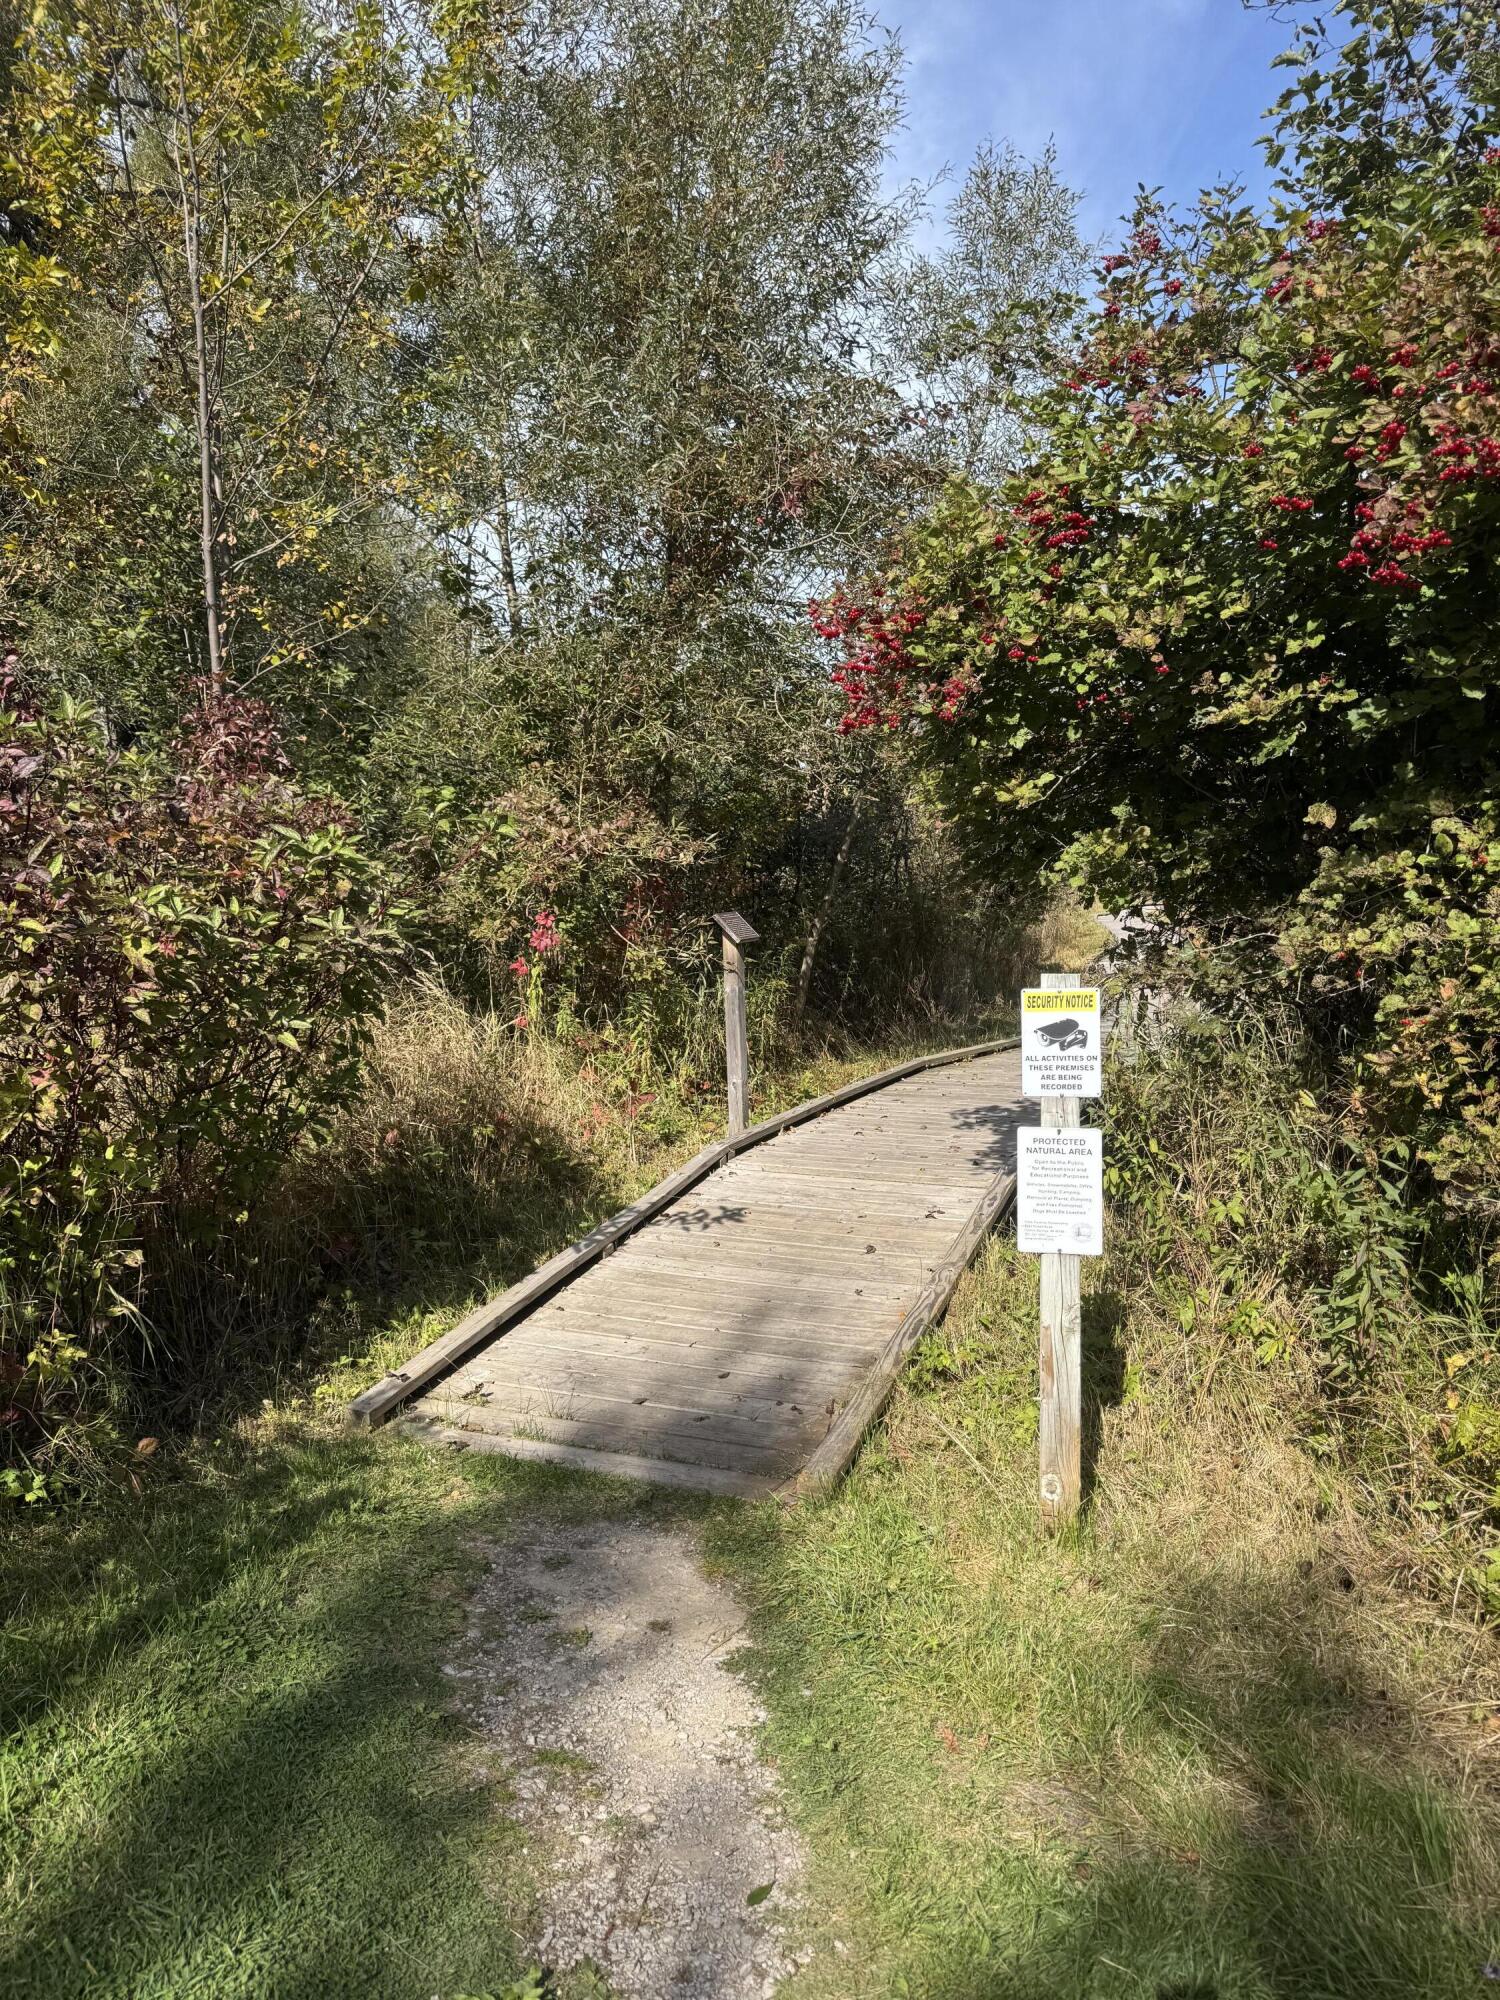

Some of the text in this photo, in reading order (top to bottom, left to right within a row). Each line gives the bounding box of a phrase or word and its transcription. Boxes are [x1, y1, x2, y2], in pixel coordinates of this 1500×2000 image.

[1027, 994, 1094, 1009] SECURITY NOTICE
[1033, 1137, 1086, 1146] PROTECTED
[1026, 1147, 1093, 1156] NATURAL AREA
